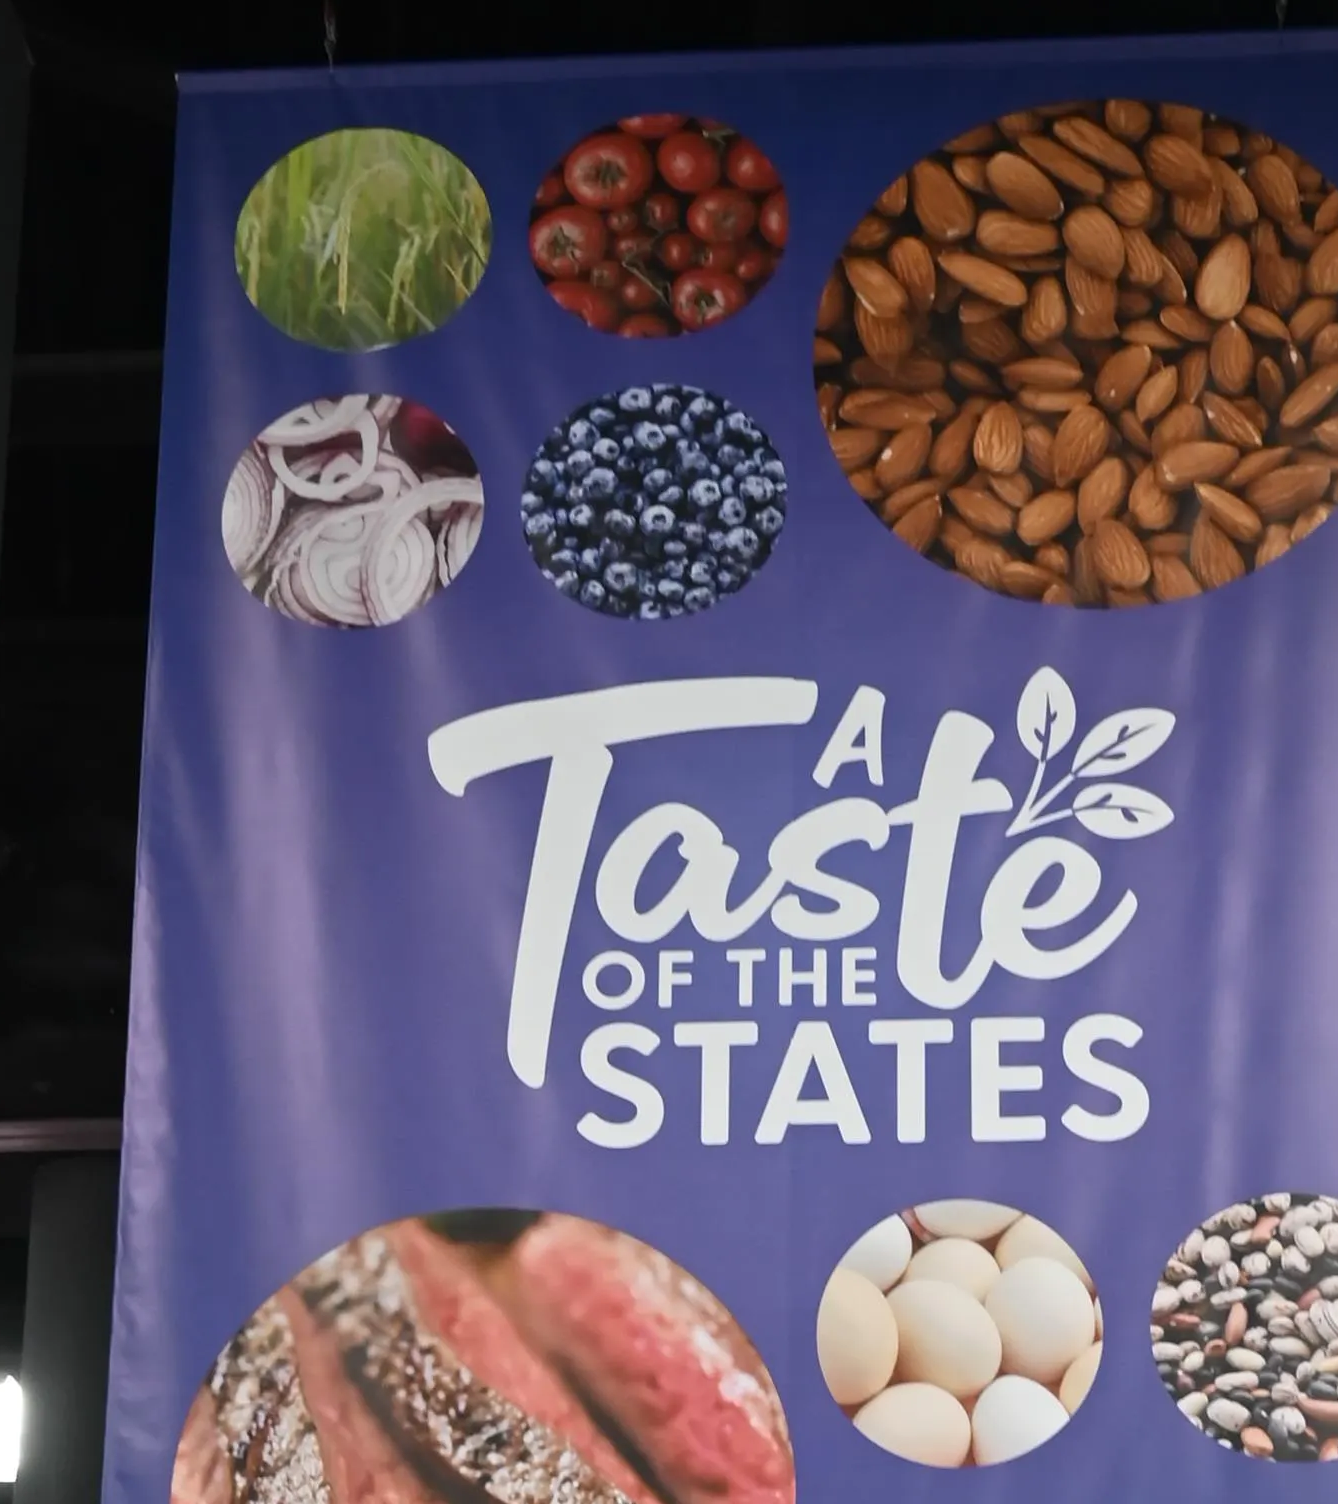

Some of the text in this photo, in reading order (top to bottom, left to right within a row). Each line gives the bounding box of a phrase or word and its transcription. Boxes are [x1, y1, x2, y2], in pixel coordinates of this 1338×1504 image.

[812, 685, 887, 788] A
[427, 676, 1138, 1088] Taste
[581, 946, 878, 1010] OF THE
[575, 1012, 1151, 1149] STATES
